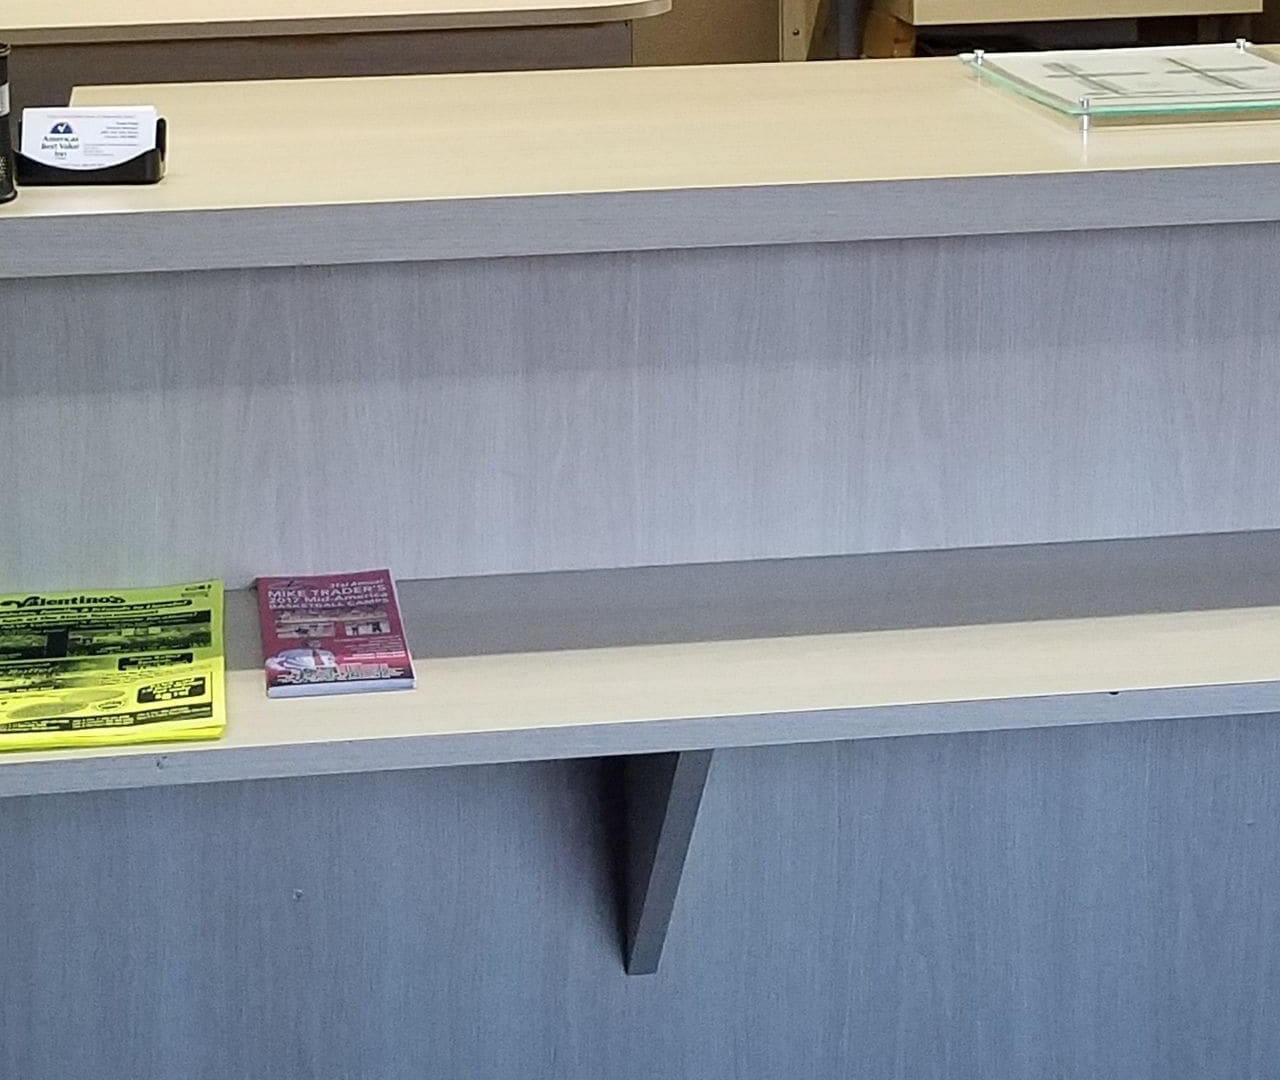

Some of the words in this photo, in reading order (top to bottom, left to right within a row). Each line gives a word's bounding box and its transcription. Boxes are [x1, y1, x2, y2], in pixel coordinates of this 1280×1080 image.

[268, 590, 306, 598] MIKE
[311, 584, 387, 597] TRADER'S
[304, 592, 389, 603] Mid-America
[0, 595, 126, 608] Valentino's
